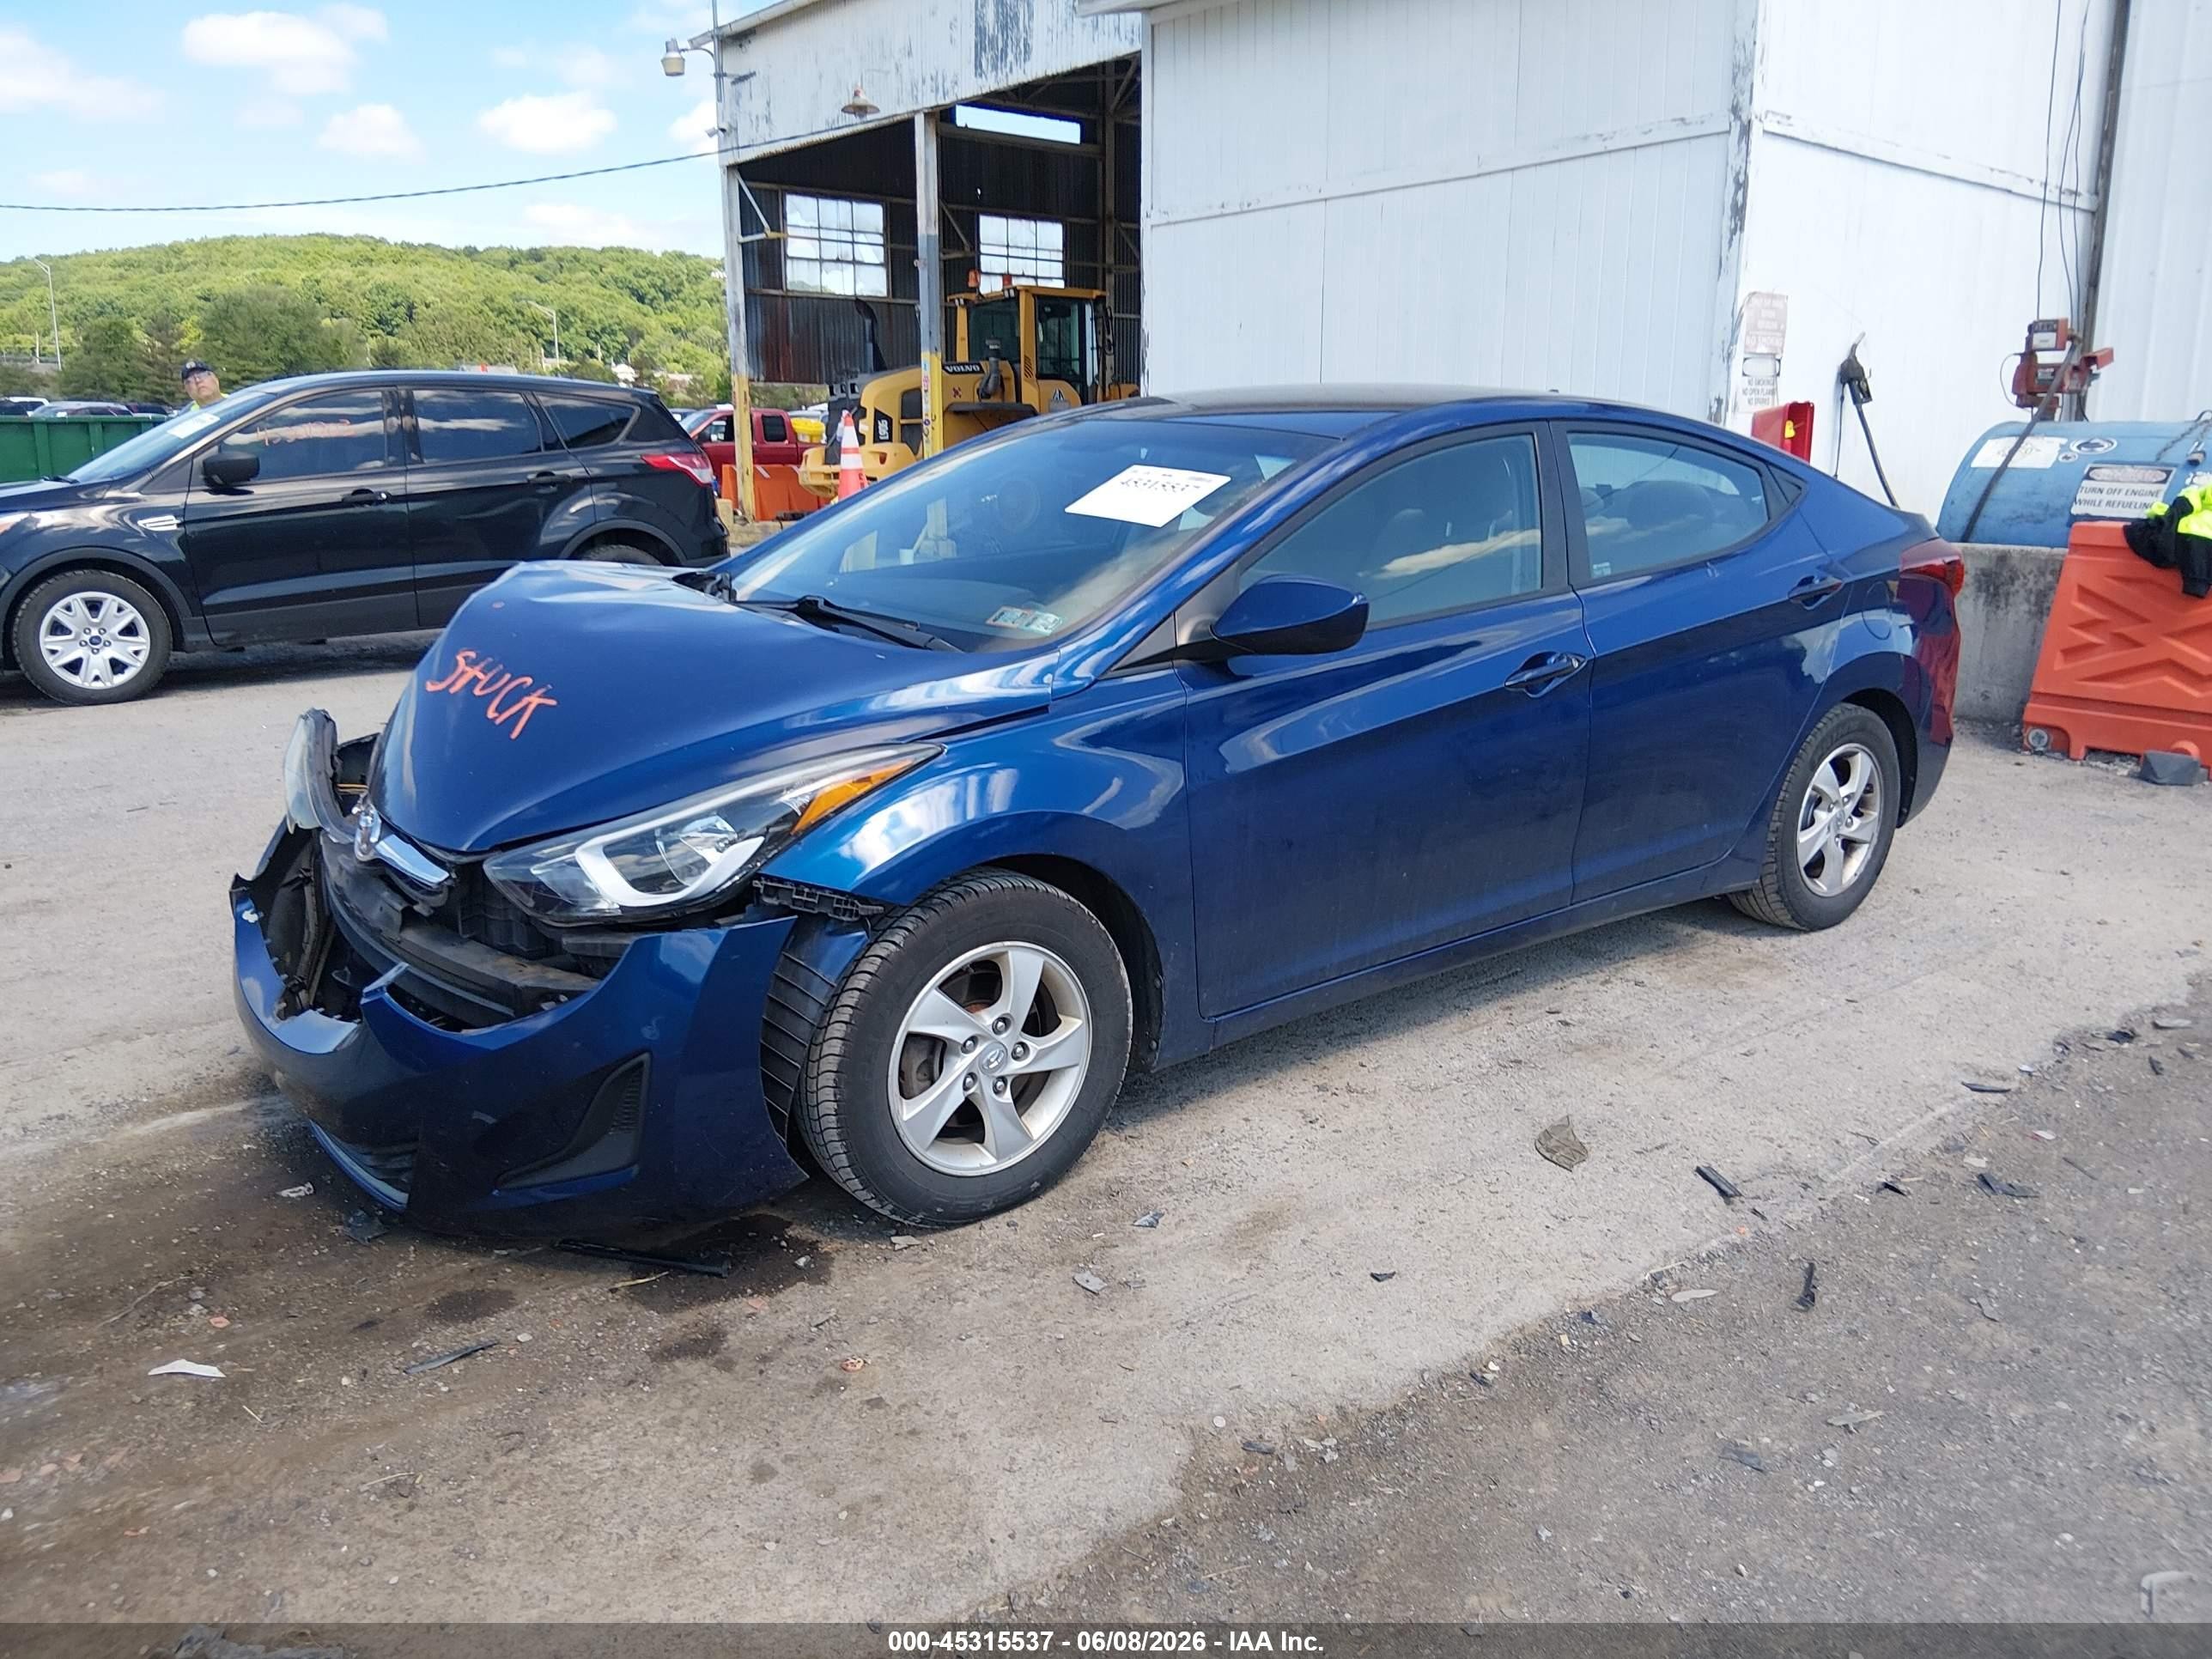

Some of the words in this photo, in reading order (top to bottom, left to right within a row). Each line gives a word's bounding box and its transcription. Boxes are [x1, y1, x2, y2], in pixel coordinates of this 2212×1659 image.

[944, 364, 981, 373] VOLVO
[2080, 486, 2105, 495] TURN
[2106, 487, 2124, 495] OFF
[2124, 489, 2160, 498] ENGINE
[2075, 499, 2103, 507] WHILE
[425, 648, 557, 740] STUCK
